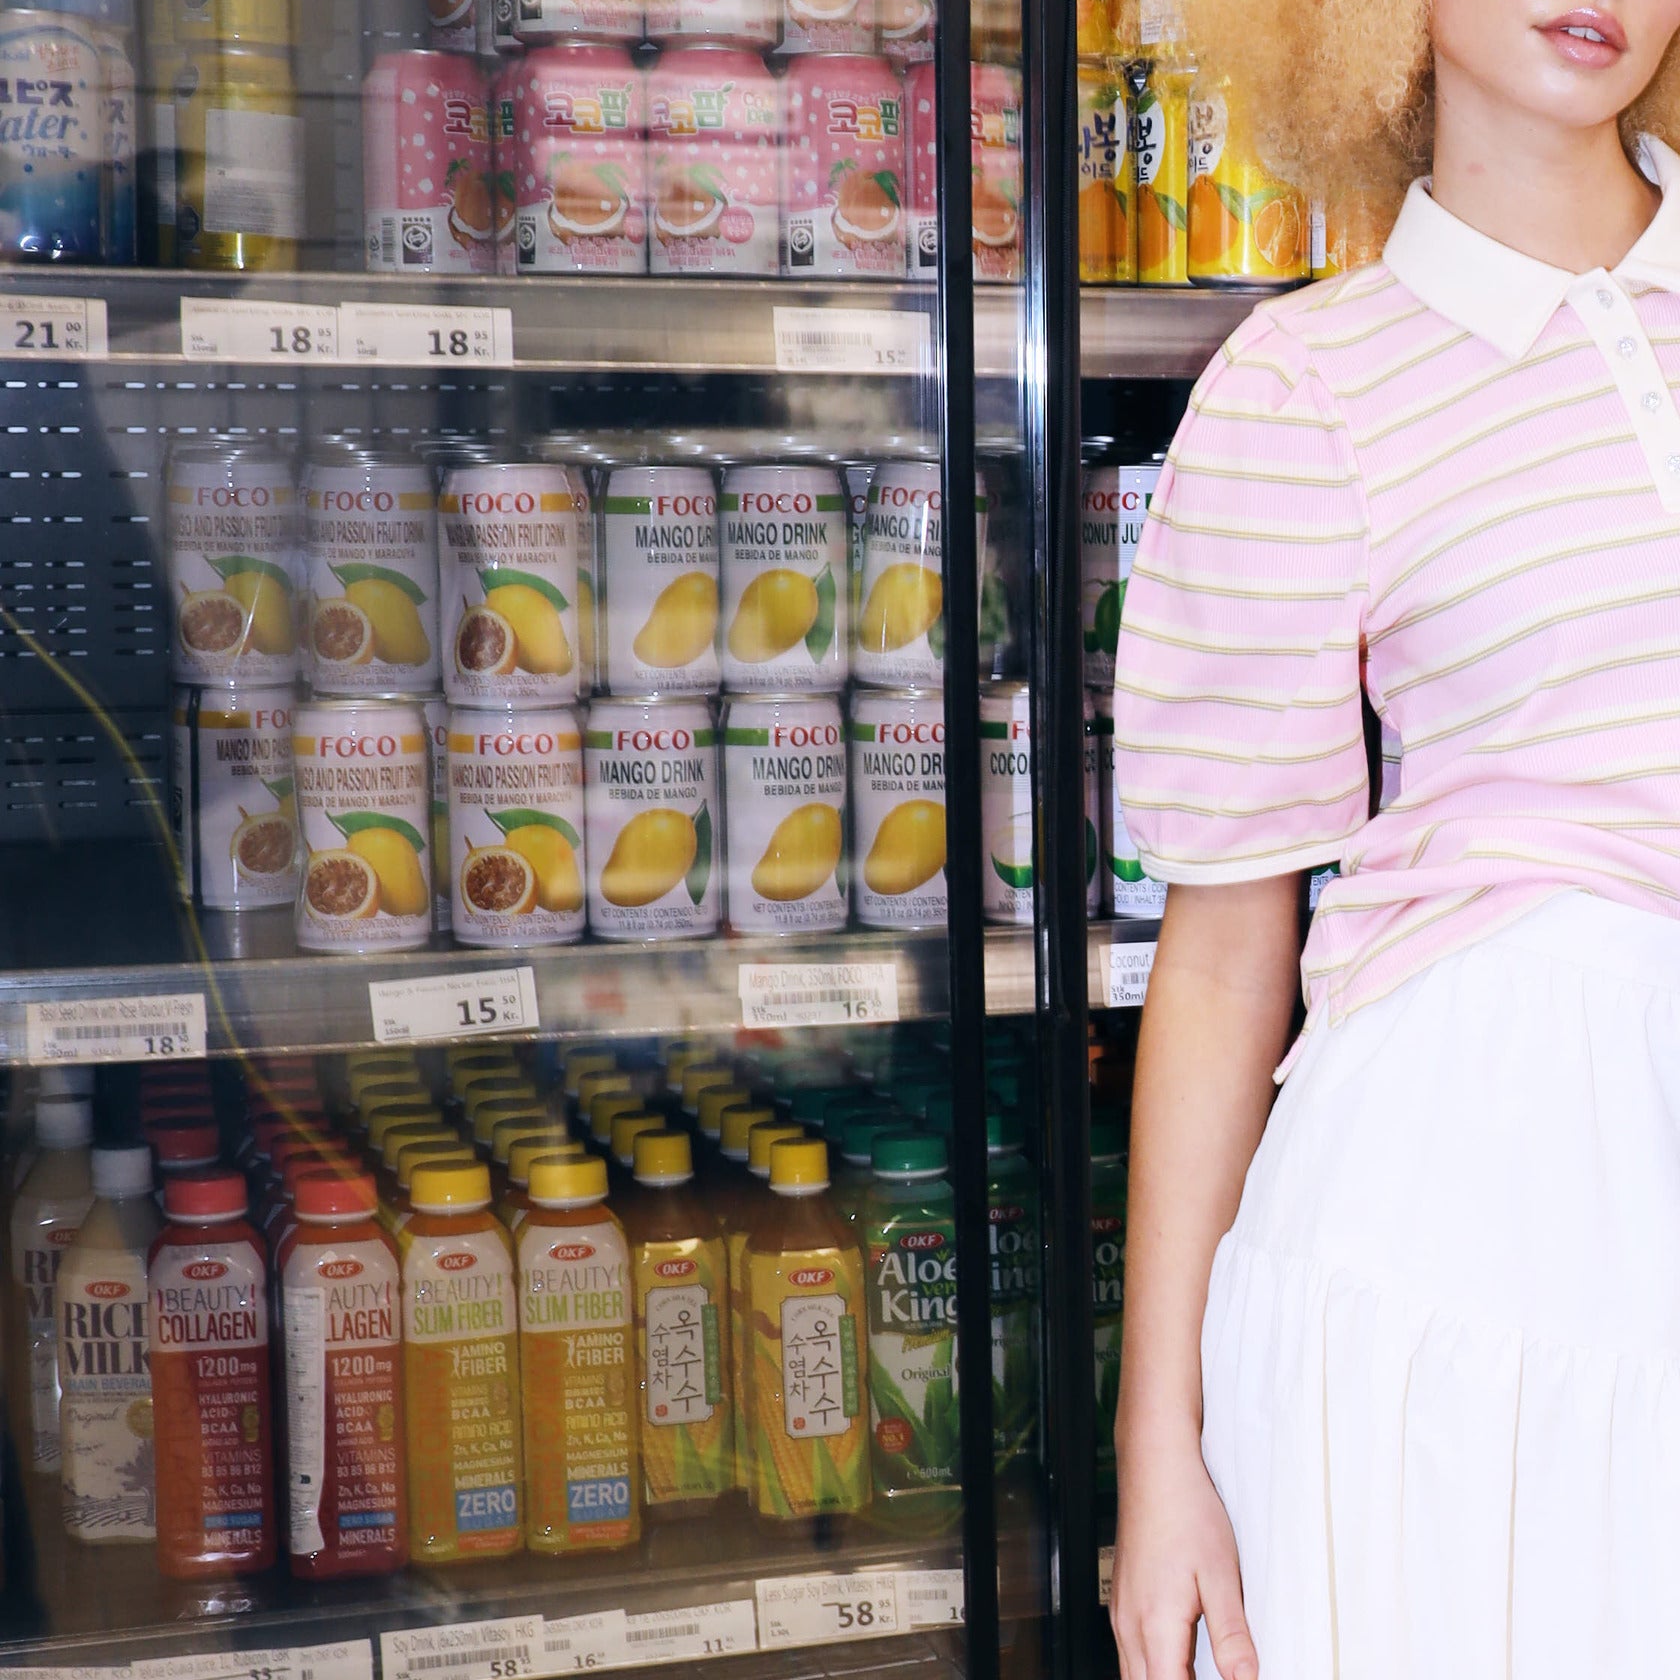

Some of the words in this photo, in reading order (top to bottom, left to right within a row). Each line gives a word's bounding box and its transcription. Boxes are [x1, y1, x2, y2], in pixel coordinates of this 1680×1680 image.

[544, 83, 633, 135] 코코팜
[15, 321, 59, 348] 21
[66, 322, 81, 332] 00
[66, 338, 82, 348] Kr.
[270, 326, 311, 354] 18
[428, 329, 469, 356] 18
[317, 343, 334, 355] Kr.
[474, 346, 490, 357] Kr.
[742, 493, 812, 514] FOCO
[635, 526, 693, 549] MANGO
[728, 523, 777, 545] MANGO
[782, 523, 828, 545] DRINK
[320, 735, 397, 758] FOCO
[478, 733, 554, 756] FOCO
[617, 729, 690, 751] FOCO
[599, 758, 655, 785] MANGO
[662, 758, 705, 783] DRINK
[752, 756, 812, 780] MANGO
[863, 753, 917, 776] MANGO
[337, 766, 378, 791] PASSION
[495, 765, 536, 788] PASSION
[871, 779, 904, 791] BEBIDA
[609, 787, 644, 800] BEBIDA
[764, 783, 801, 796] BEBIDA
[1109, 953, 1150, 968] Coconut
[1112, 992, 1144, 1001] 350ml
[457, 997, 497, 1026] 15
[502, 995, 516, 1005] 50
[503, 1011, 519, 1020] Kr.
[843, 1001, 868, 1018] 16
[145, 1037, 174, 1055] 18
[907, 1235, 937, 1247] OKF
[796, 1271, 825, 1284] OKF
[526, 1294, 567, 1324] SLIM
[574, 1290, 624, 1321] FIBER
[413, 1305, 453, 1335] SLIM
[457, 1299, 503, 1331] FIBER
[158, 1311, 257, 1344] COLLAGEN
[461, 1342, 505, 1356] AMINO
[576, 1332, 624, 1348] AMINO
[576, 1347, 625, 1367] FIBER
[651, 1323, 672, 1391] 수염차
[670, 1309, 703, 1413] 옥수수
[461, 1356, 507, 1377] FIBER
[786, 1335, 810, 1403] 수염차
[806, 1320, 841, 1427] 옥수수
[901, 1365, 950, 1383] Original
[199, 1391, 257, 1403] HYALURONIC
[334, 1390, 393, 1404] HYALURONIC
[565, 1397, 606, 1409] BCAA
[202, 1408, 229, 1418] ACID
[336, 1408, 365, 1418] ACID
[201, 1423, 239, 1434] BCAA
[336, 1422, 373, 1434] BCAA
[567, 1462, 628, 1480] MINERALS
[338, 1497, 396, 1511] MAGNESIUM
[458, 1489, 516, 1517] ZERO
[571, 1482, 629, 1508] ZERO
[202, 1498, 263, 1511] MAGNESIUM
[204, 1529, 262, 1546] MINERALS
[339, 1529, 395, 1545] MINERALS
[839, 1601, 874, 1628] 58
[878, 1599, 891, 1608] 95
[879, 1615, 893, 1623] Kr.
[702, 1639, 724, 1655] 11
[490, 1659, 518, 1680] 58
[573, 1654, 596, 1669] 16
